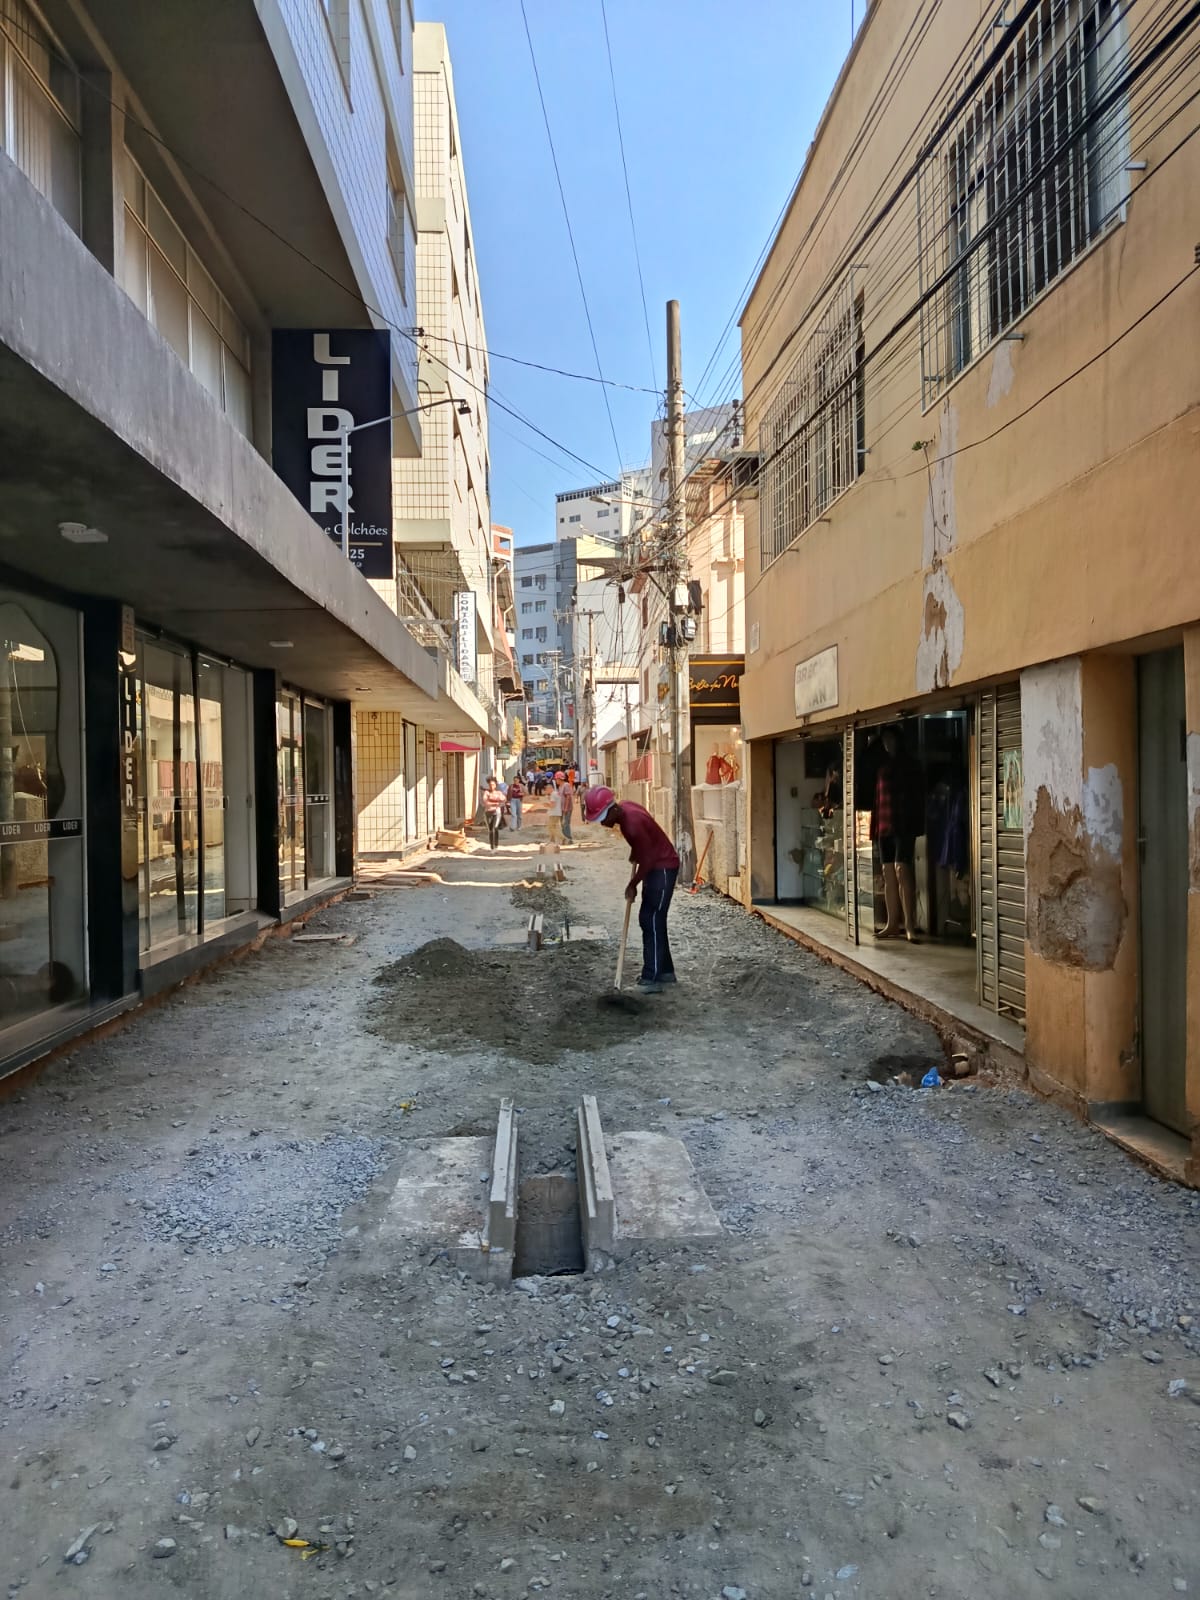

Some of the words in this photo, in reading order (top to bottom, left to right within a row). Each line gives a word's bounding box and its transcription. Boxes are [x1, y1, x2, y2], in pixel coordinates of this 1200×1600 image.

[306, 333, 355, 513] LIDER
[334, 522, 388, 535] Clchões
[125, 677, 134, 807] LIDER
[2, 824, 21, 836] LIDER
[34, 822, 51, 833] LIDER
